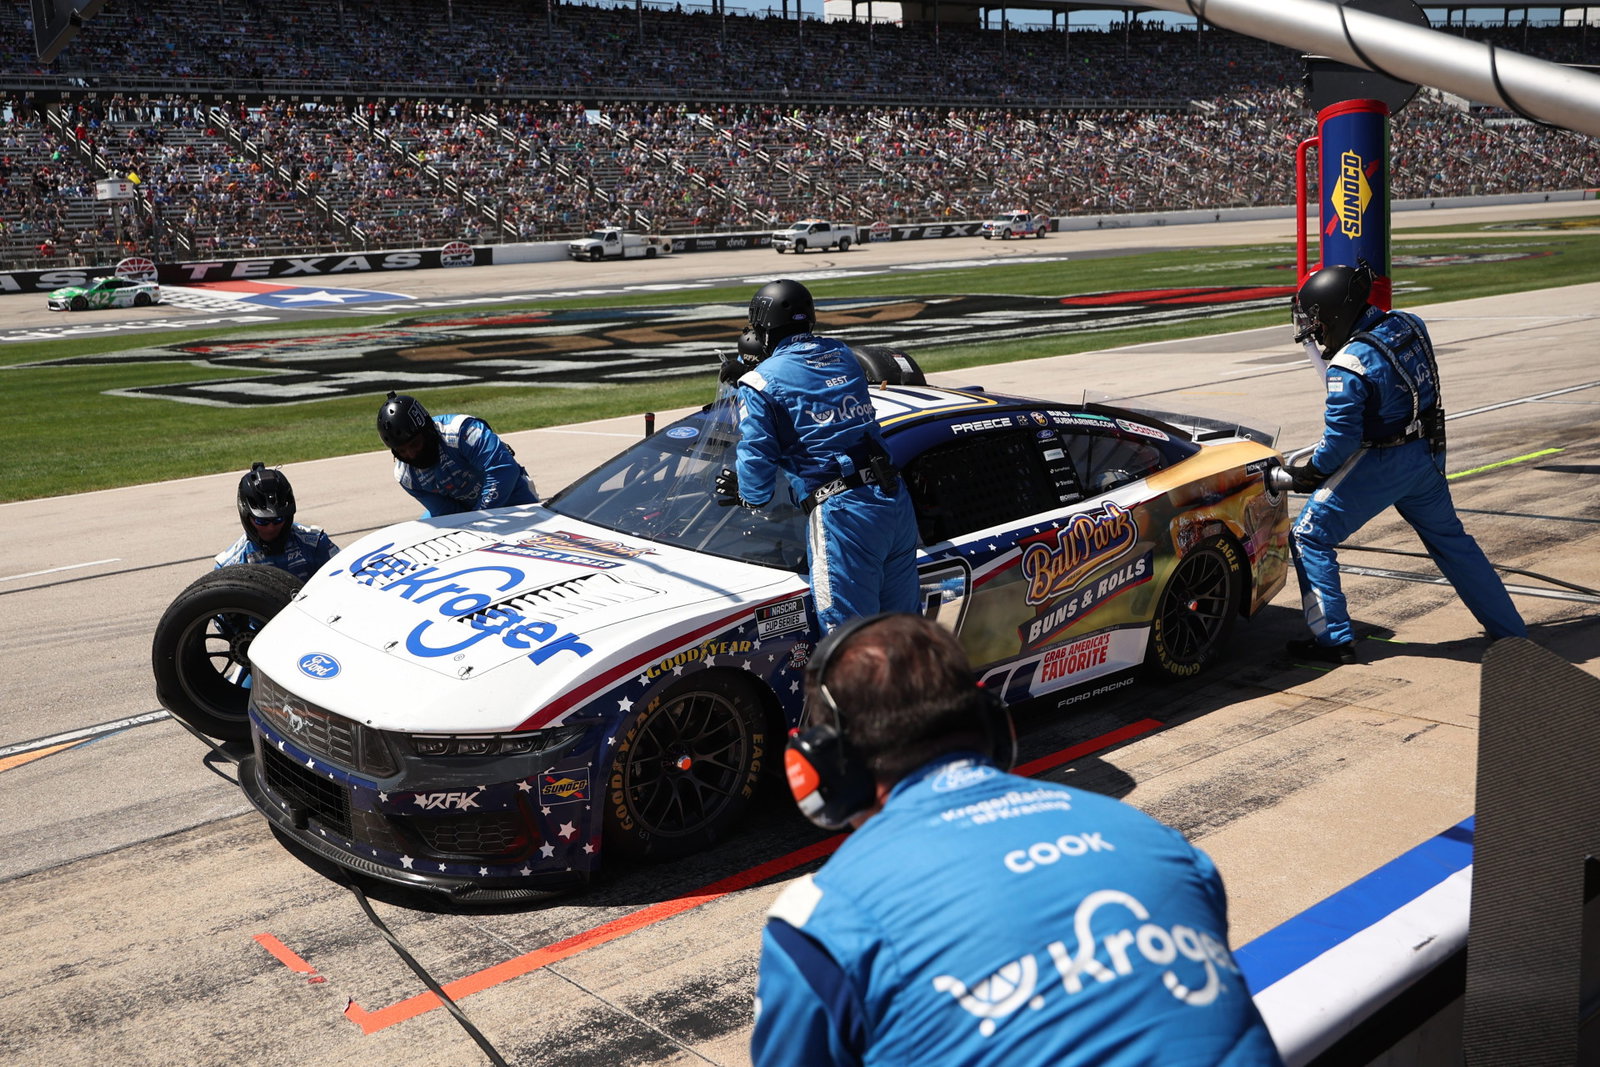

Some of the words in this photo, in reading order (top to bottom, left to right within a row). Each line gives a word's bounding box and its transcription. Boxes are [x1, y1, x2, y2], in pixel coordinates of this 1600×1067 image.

[1343, 153, 1360, 235] SUNOCO
[726, 238, 747, 248] xfinity
[898, 225, 983, 239] TEX
[181, 253, 422, 280] TEXAS
[825, 375, 848, 388] BEST
[951, 417, 1012, 434] PREECE
[1053, 417, 1117, 429] SUBMARINES.COM
[1128, 423, 1167, 439] Castrol
[503, 546, 545, 556] BUNS
[562, 556, 616, 568] ROLLS
[1026, 531, 1081, 599] Ball
[1074, 506, 1132, 560] Park
[1215, 538, 1239, 573] EAGLE
[771, 601, 797, 617] NASCAR
[1028, 598, 1078, 644] BUNS
[1081, 589, 1094, 609] &
[1097, 558, 1146, 599] ROLLS
[380, 566, 593, 666] Kroger
[765, 619, 779, 632] CUP
[779, 615, 800, 629] SERIES
[646, 639, 752, 679] GOODYEAR
[1044, 647, 1066, 663] GRAB
[1068, 633, 1111, 656] AMERICA'S
[302, 655, 334, 678] Ford
[1041, 645, 1108, 683] FAVORITE
[1057, 690, 1091, 708] FORD
[1092, 677, 1135, 696] RACING
[742, 733, 764, 799] EAGLE
[425, 791, 481, 808] RFK
[542, 780, 587, 797] SUNOCO
[941, 788, 1072, 822] KrogerRacing
[1004, 831, 1116, 874] COOK
